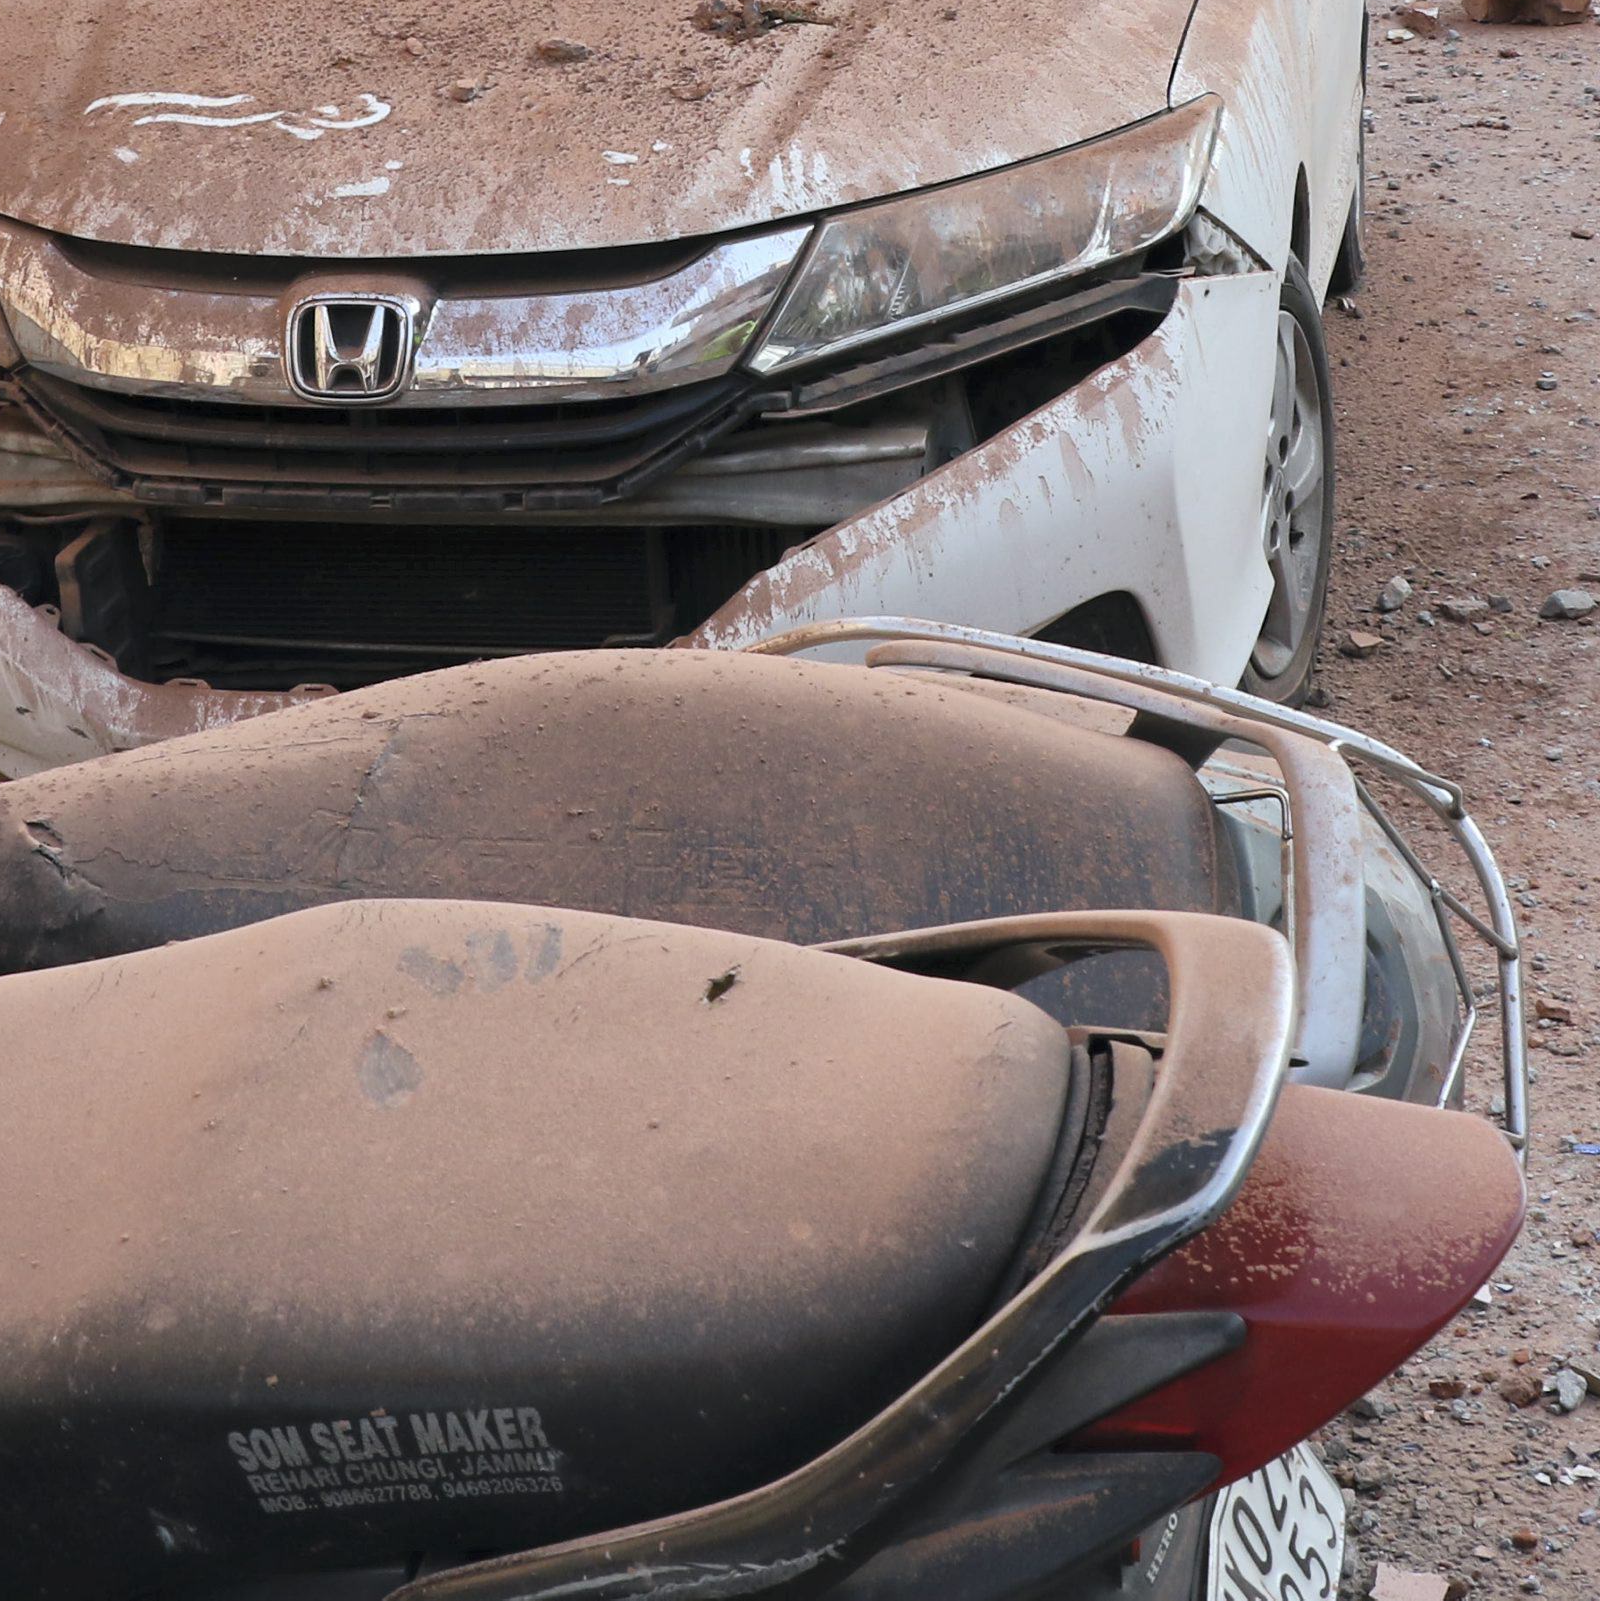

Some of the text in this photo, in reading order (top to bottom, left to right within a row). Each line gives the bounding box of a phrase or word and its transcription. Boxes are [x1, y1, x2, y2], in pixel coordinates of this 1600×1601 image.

[226, 1406, 552, 1473] SOM SEAT MAKER
[246, 1468, 342, 1495] REHARI
[342, 1456, 455, 1486] CHUNGI,
[1146, 1512, 1178, 1584] HERO
